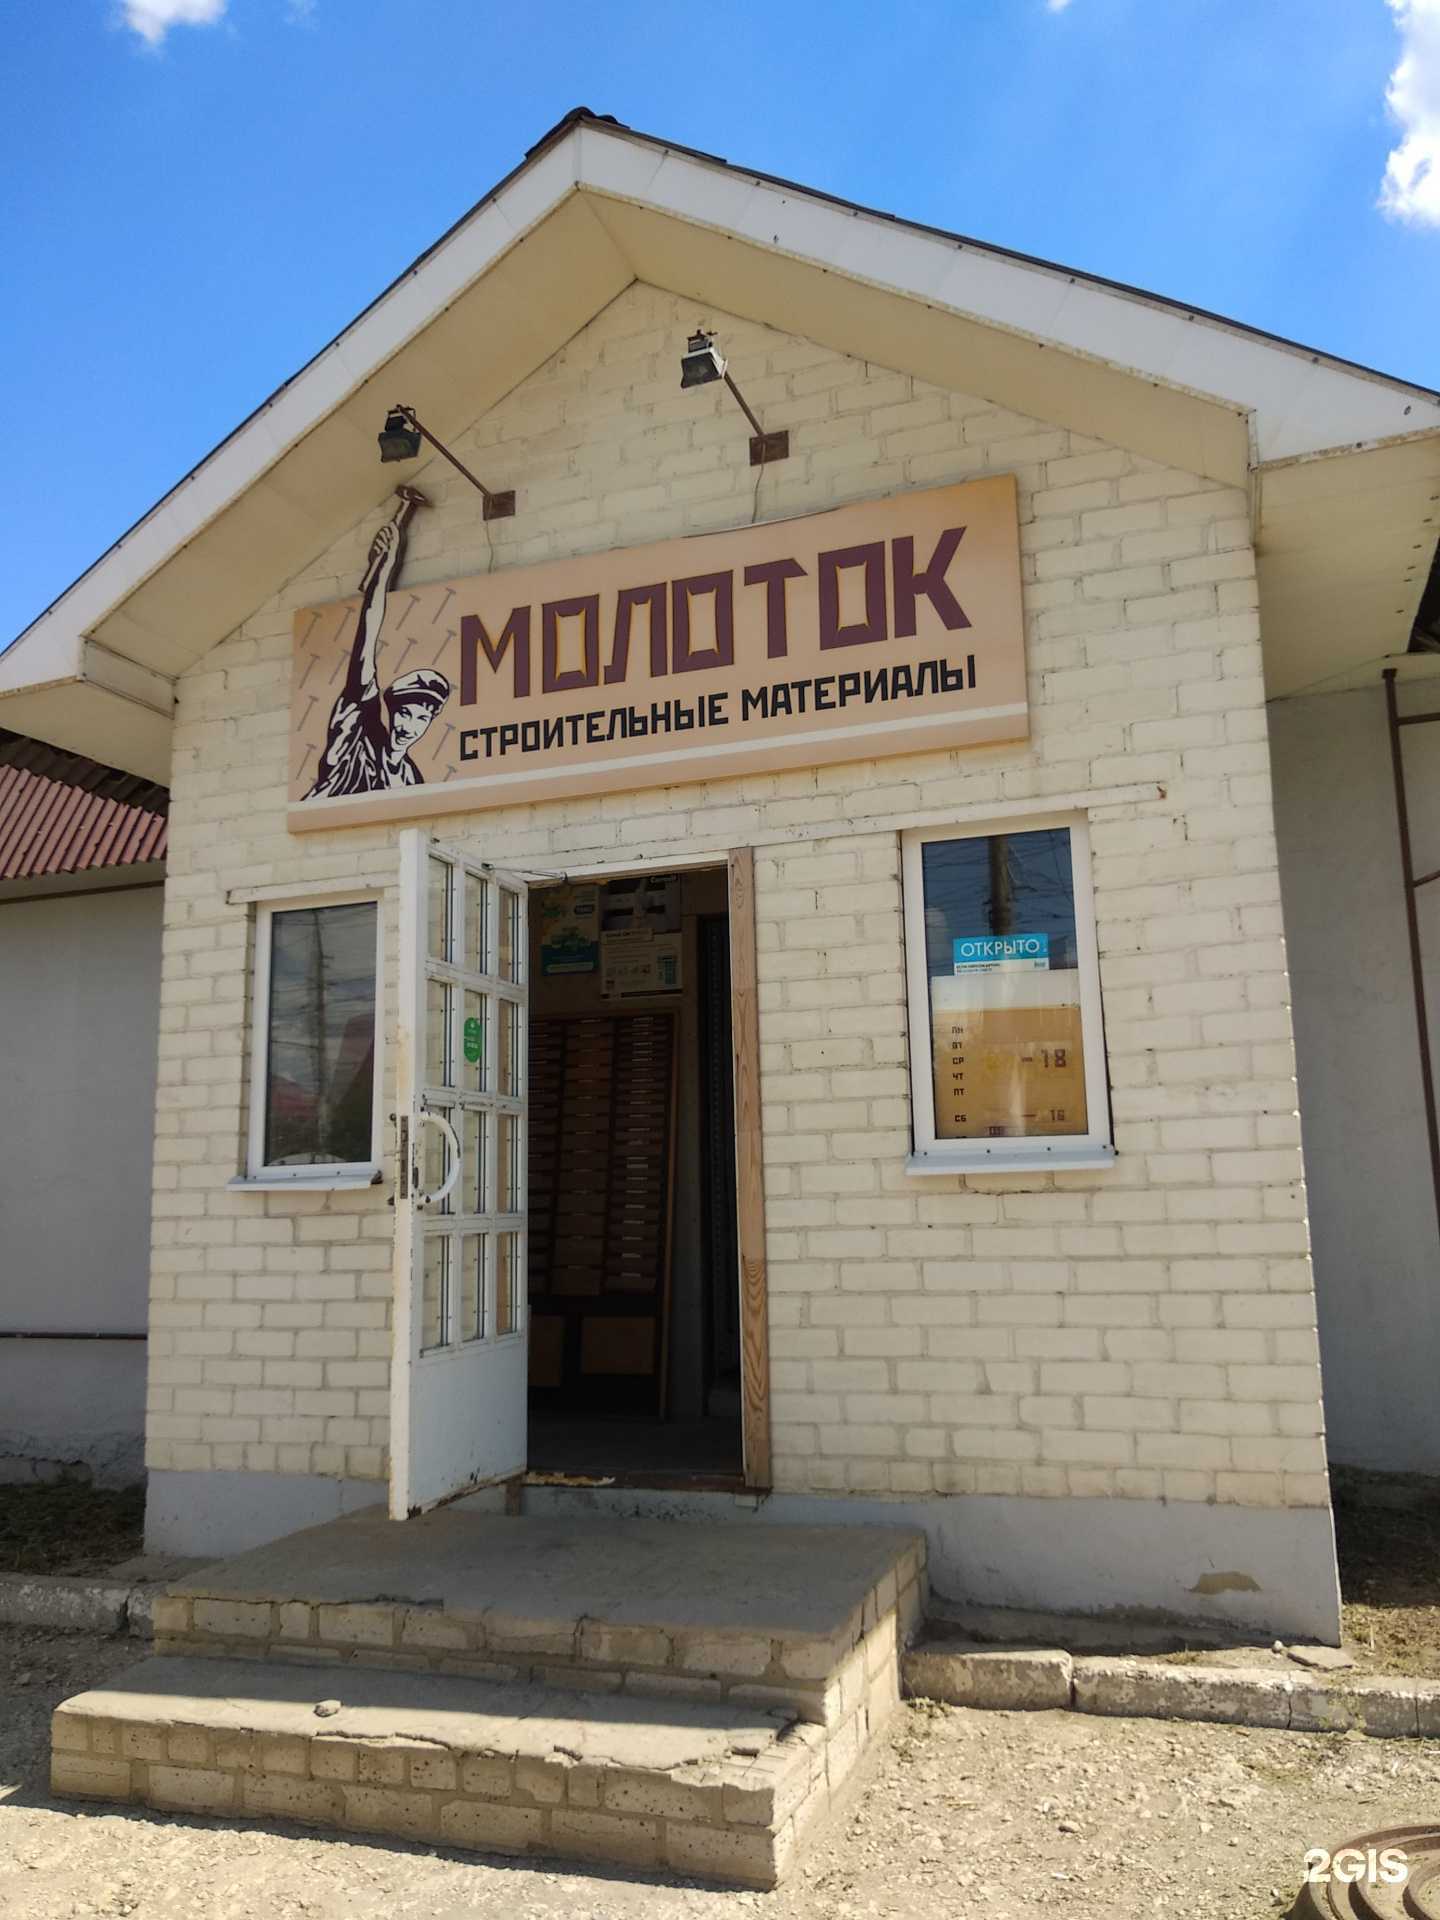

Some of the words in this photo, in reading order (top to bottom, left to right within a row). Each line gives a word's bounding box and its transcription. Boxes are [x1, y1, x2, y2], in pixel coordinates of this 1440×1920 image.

[461, 526, 972, 706] МОЛОТОК
[460, 692, 729, 760] СТРОИТЕЛЬНЫЕ
[741, 655, 976, 719] МАТЕРИАЛЫ
[960, 939, 1040, 957] ОТКРЫТО
[952, 1056, 964, 1065] СР
[952, 1072, 964, 1080] ЧТ
[953, 1088, 965, 1096] ПТ
[954, 1114, 967, 1122] СБ
